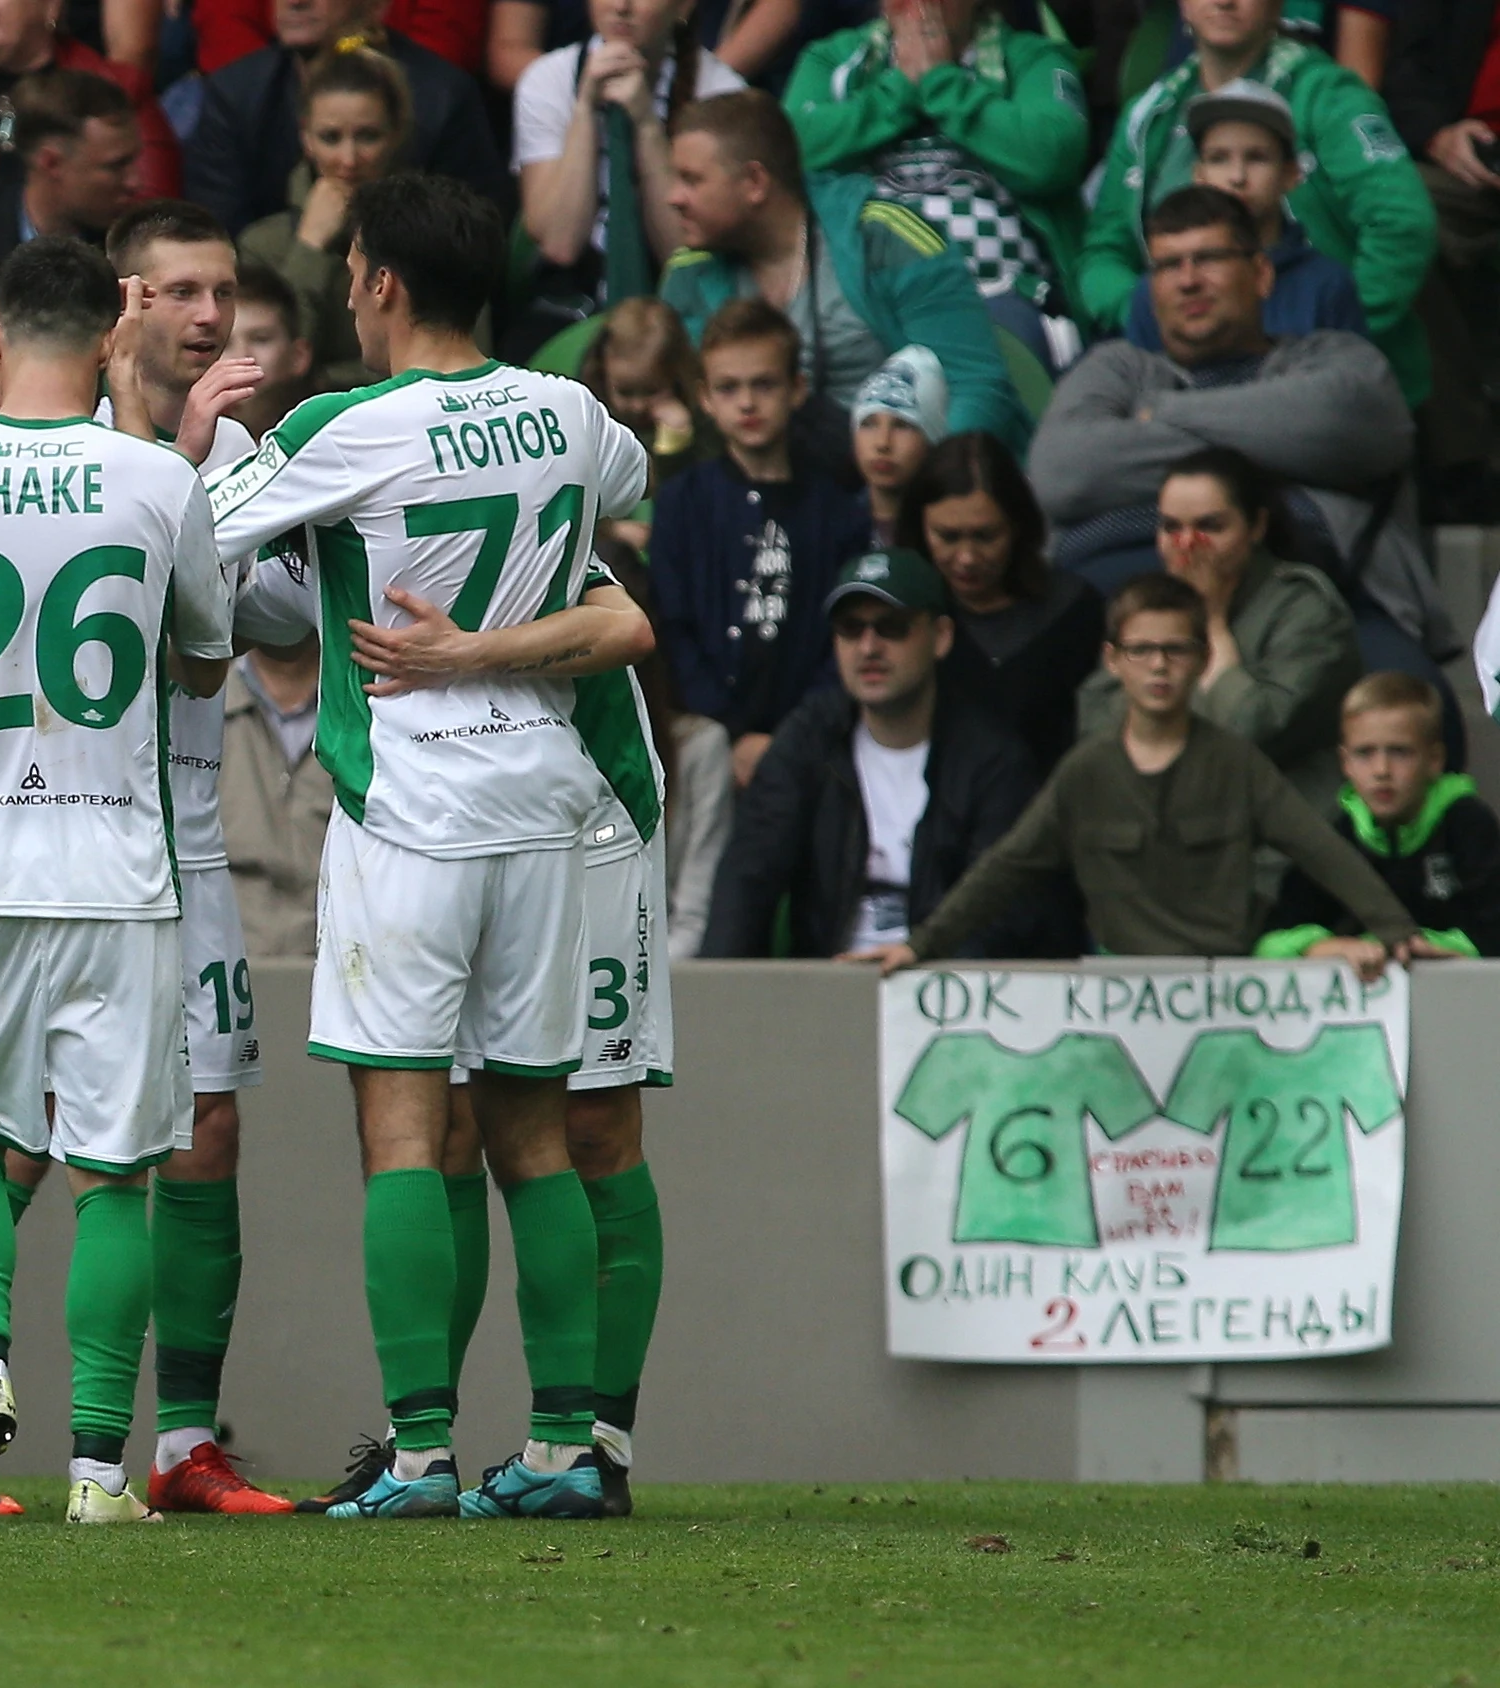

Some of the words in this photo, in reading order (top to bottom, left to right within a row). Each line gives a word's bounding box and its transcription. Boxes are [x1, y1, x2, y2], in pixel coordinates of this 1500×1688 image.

[468, 384, 529, 410] КОС
[15, 441, 85, 458] КОС
[426, 408, 567, 473] ПОПОВ
[403, 484, 585, 633] 71
[199, 957, 255, 1035] 19
[915, 970, 1021, 1026] ФК
[1064, 969, 1393, 1026] КРАСНОДАР
[988, 1105, 1058, 1184] 6
[1237, 1097, 1333, 1181] 22
[899, 1252, 1034, 1303] ОДИН
[1061, 1251, 1190, 1297] КЛУБ
[1029, 1296, 1088, 1350] 2
[1100, 1284, 1379, 1346] ЛЕГЕНДЫ
